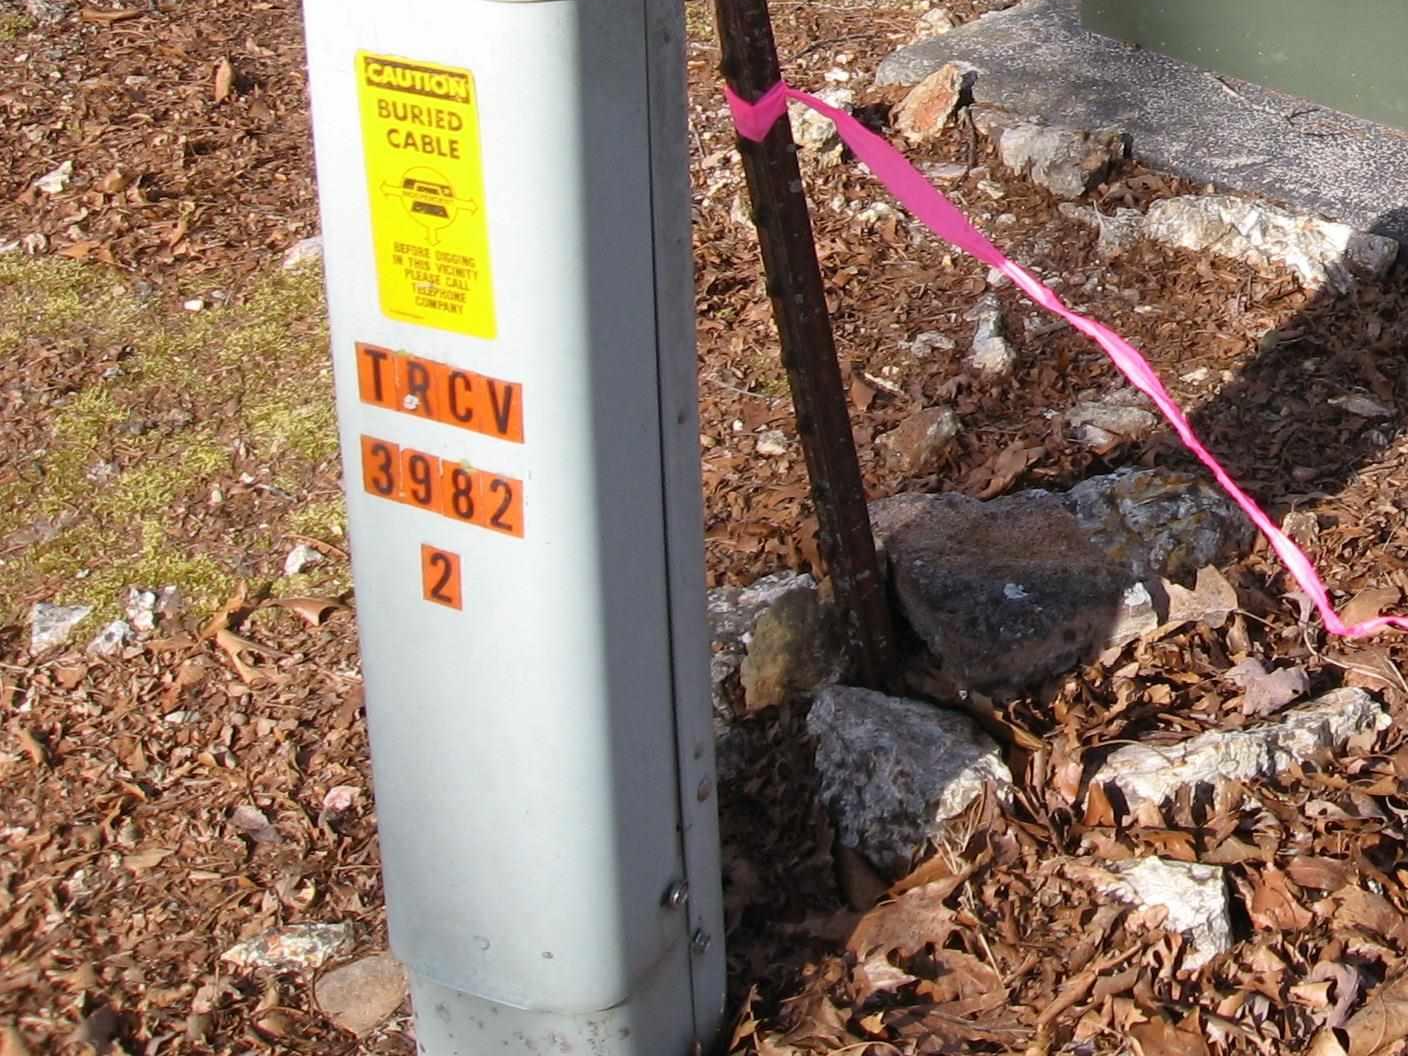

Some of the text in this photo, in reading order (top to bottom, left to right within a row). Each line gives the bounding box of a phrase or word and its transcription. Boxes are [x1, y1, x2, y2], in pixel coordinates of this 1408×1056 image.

[367, 63, 468, 98] CAUTION
[377, 98, 463, 132] BURIED
[386, 128, 461, 160] CABLE
[392, 254, 478, 281] IN THIS VICINITY
[393, 241, 477, 268] BEFORE DIGGING
[404, 268, 470, 292] PLEASE CALL
[411, 282, 467, 304] TELEPHONE
[415, 295, 464, 315] COMPANY
[364, 348, 514, 435] TRCV
[371, 444, 514, 532] 3982
[430, 552, 453, 604] 2
